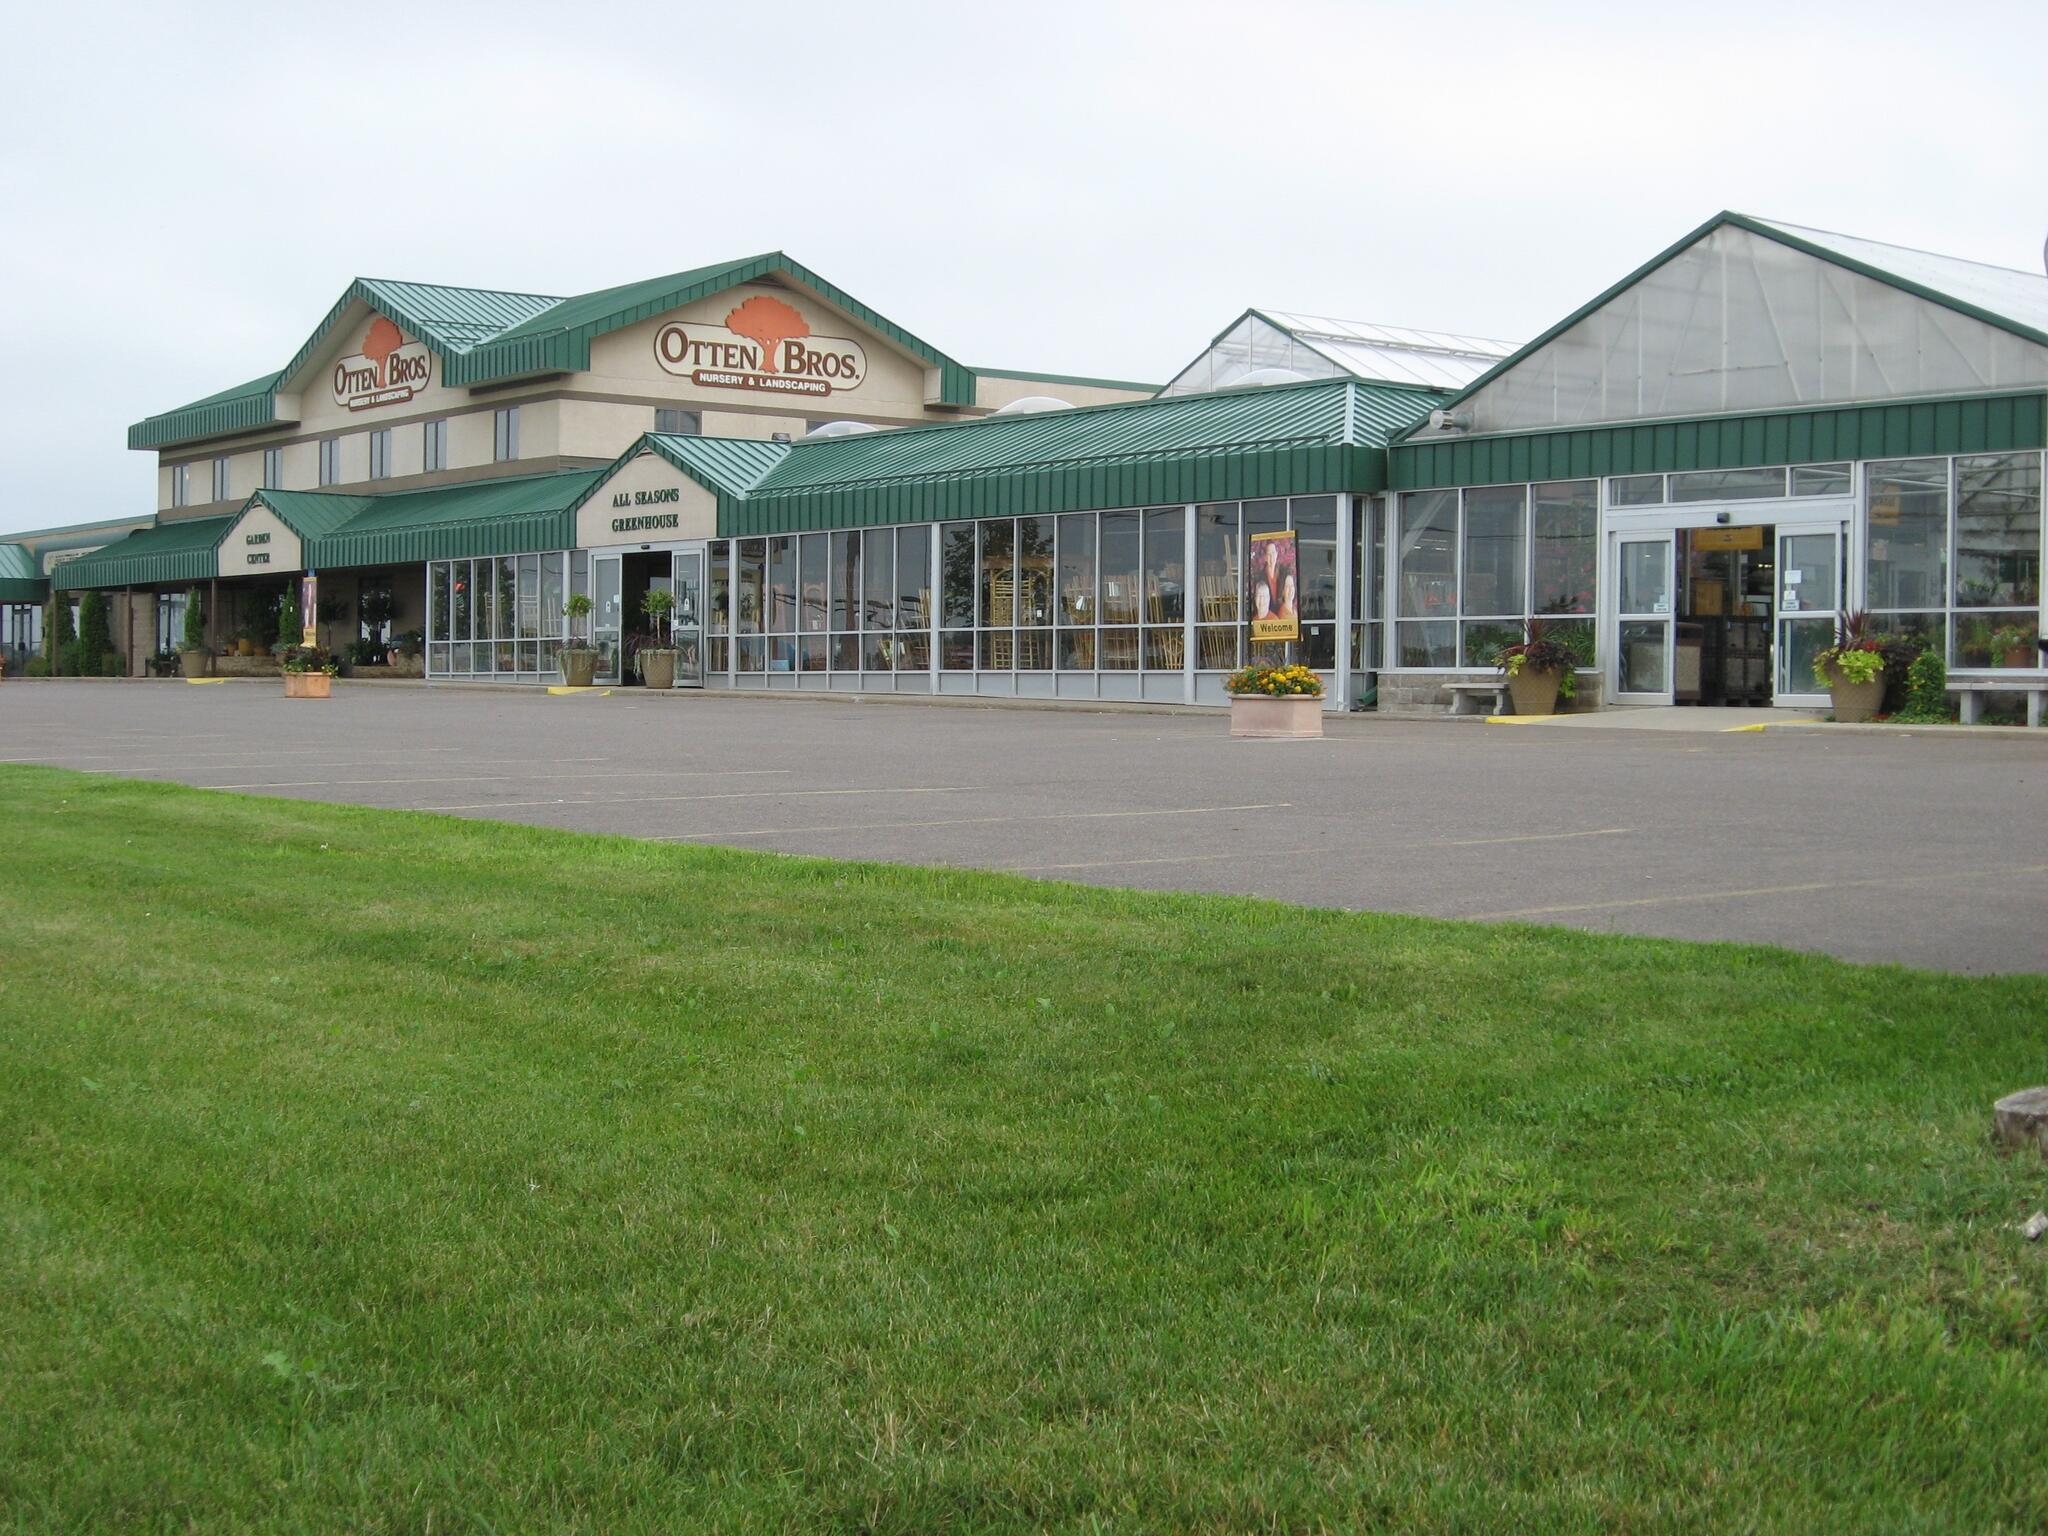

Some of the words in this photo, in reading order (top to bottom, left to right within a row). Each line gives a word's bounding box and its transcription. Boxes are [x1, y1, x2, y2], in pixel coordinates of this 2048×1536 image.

[660, 327, 757, 370] OTTEN
[783, 340, 860, 380] BROS.
[334, 363, 378, 395] OTTEN
[699, 373, 744, 385] NURSERY
[748, 377, 755, 386] &
[759, 378, 826, 392] LANDSCAPING
[612, 493, 631, 507] ALL
[635, 488, 680, 505] SEASONS
[612, 514, 679, 532] GREENHOUSE
[246, 533, 271, 545] GARDEN
[247, 553, 270, 564] CENTER
[1260, 623, 1293, 633] Welcome
